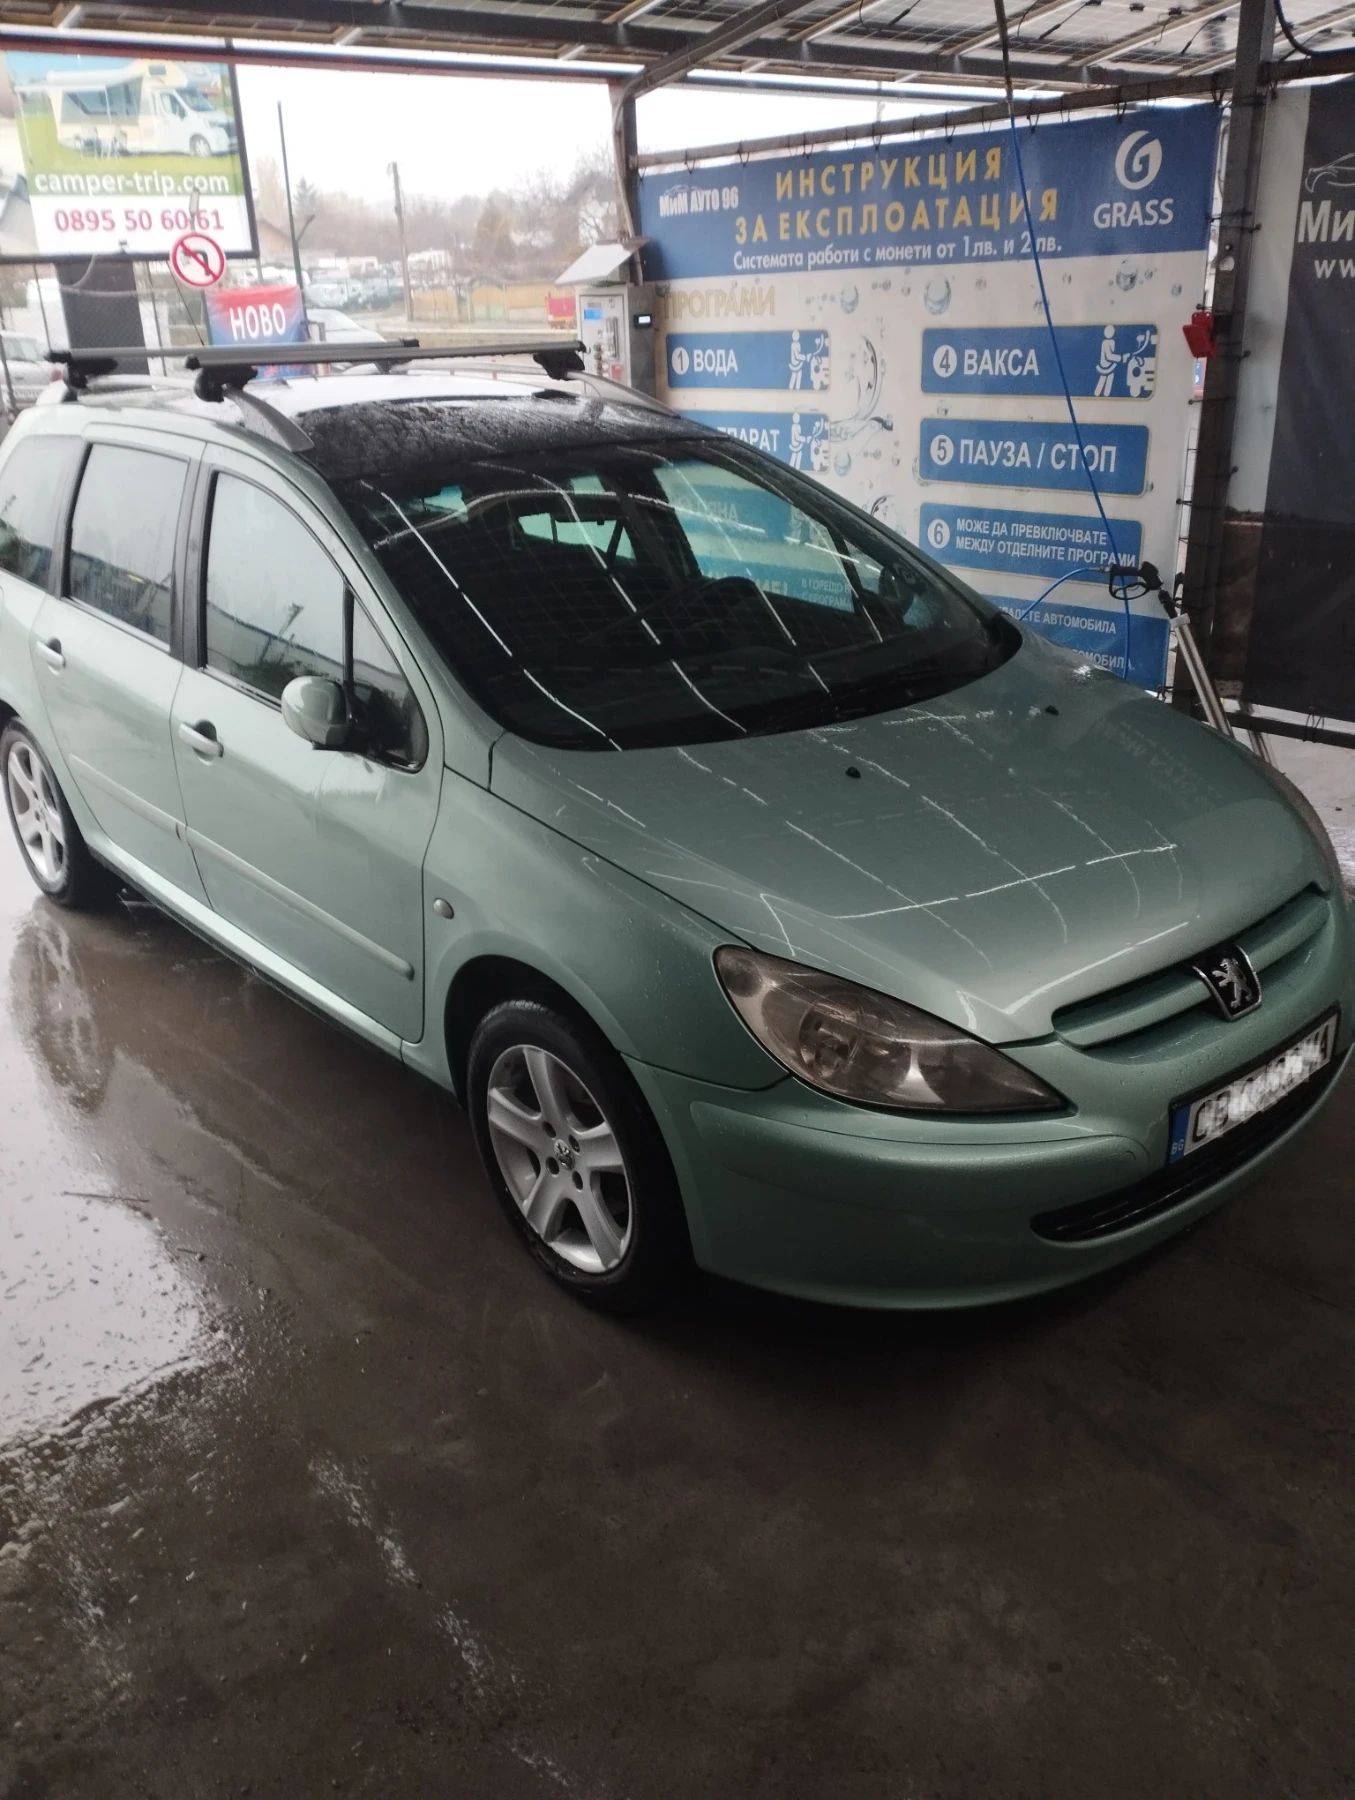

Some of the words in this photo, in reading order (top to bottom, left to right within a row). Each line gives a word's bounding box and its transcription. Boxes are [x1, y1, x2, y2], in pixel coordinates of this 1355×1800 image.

[35, 170, 230, 196] camper-trip.com
[775, 146, 1001, 201] ИНСТРУКЦИЯ
[722, 185, 739, 210] 96
[55, 208, 116, 232] 0895
[125, 209, 152, 232] 50
[161, 208, 190, 231] 60
[196, 207, 224, 231] 61
[735, 214, 768, 245] ЗА
[779, 187, 1058, 242] ЕКСПЛОАТАЦИЯ
[1093, 197, 1174, 229] GRASS
[733, 251, 804, 271] Системата
[807, 243, 859, 271] работи
[863, 247, 871, 262] с
[875, 242, 932, 262] монети
[937, 242, 956, 259] от
[1003, 239, 1015, 255] и
[664, 286, 776, 320] ПРОГРАМИ
[229, 303, 286, 341] НОВО
[693, 349, 738, 377] ВОДА
[963, 348, 1040, 376] ВАКСА
[959, 438, 1031, 468] ПАУЗА
[1036, 442, 1046, 468] /
[1050, 442, 1117, 473] СТОП
[956, 517, 990, 535] МОЖЕ
[991, 521, 1008, 536] ДА
[1010, 523, 1107, 546] ПРЕВКЛЮЧВАТЕ
[955, 535, 995, 554] МЕЖДУ
[997, 539, 1065, 562] ОТДЕЛНИТЕ
[1067, 547, 1136, 568] ПРОГРАМИ
[1043, 612, 1117, 635] АВТОМОБИЛА
[1171, 1138, 1186, 1155] BG
